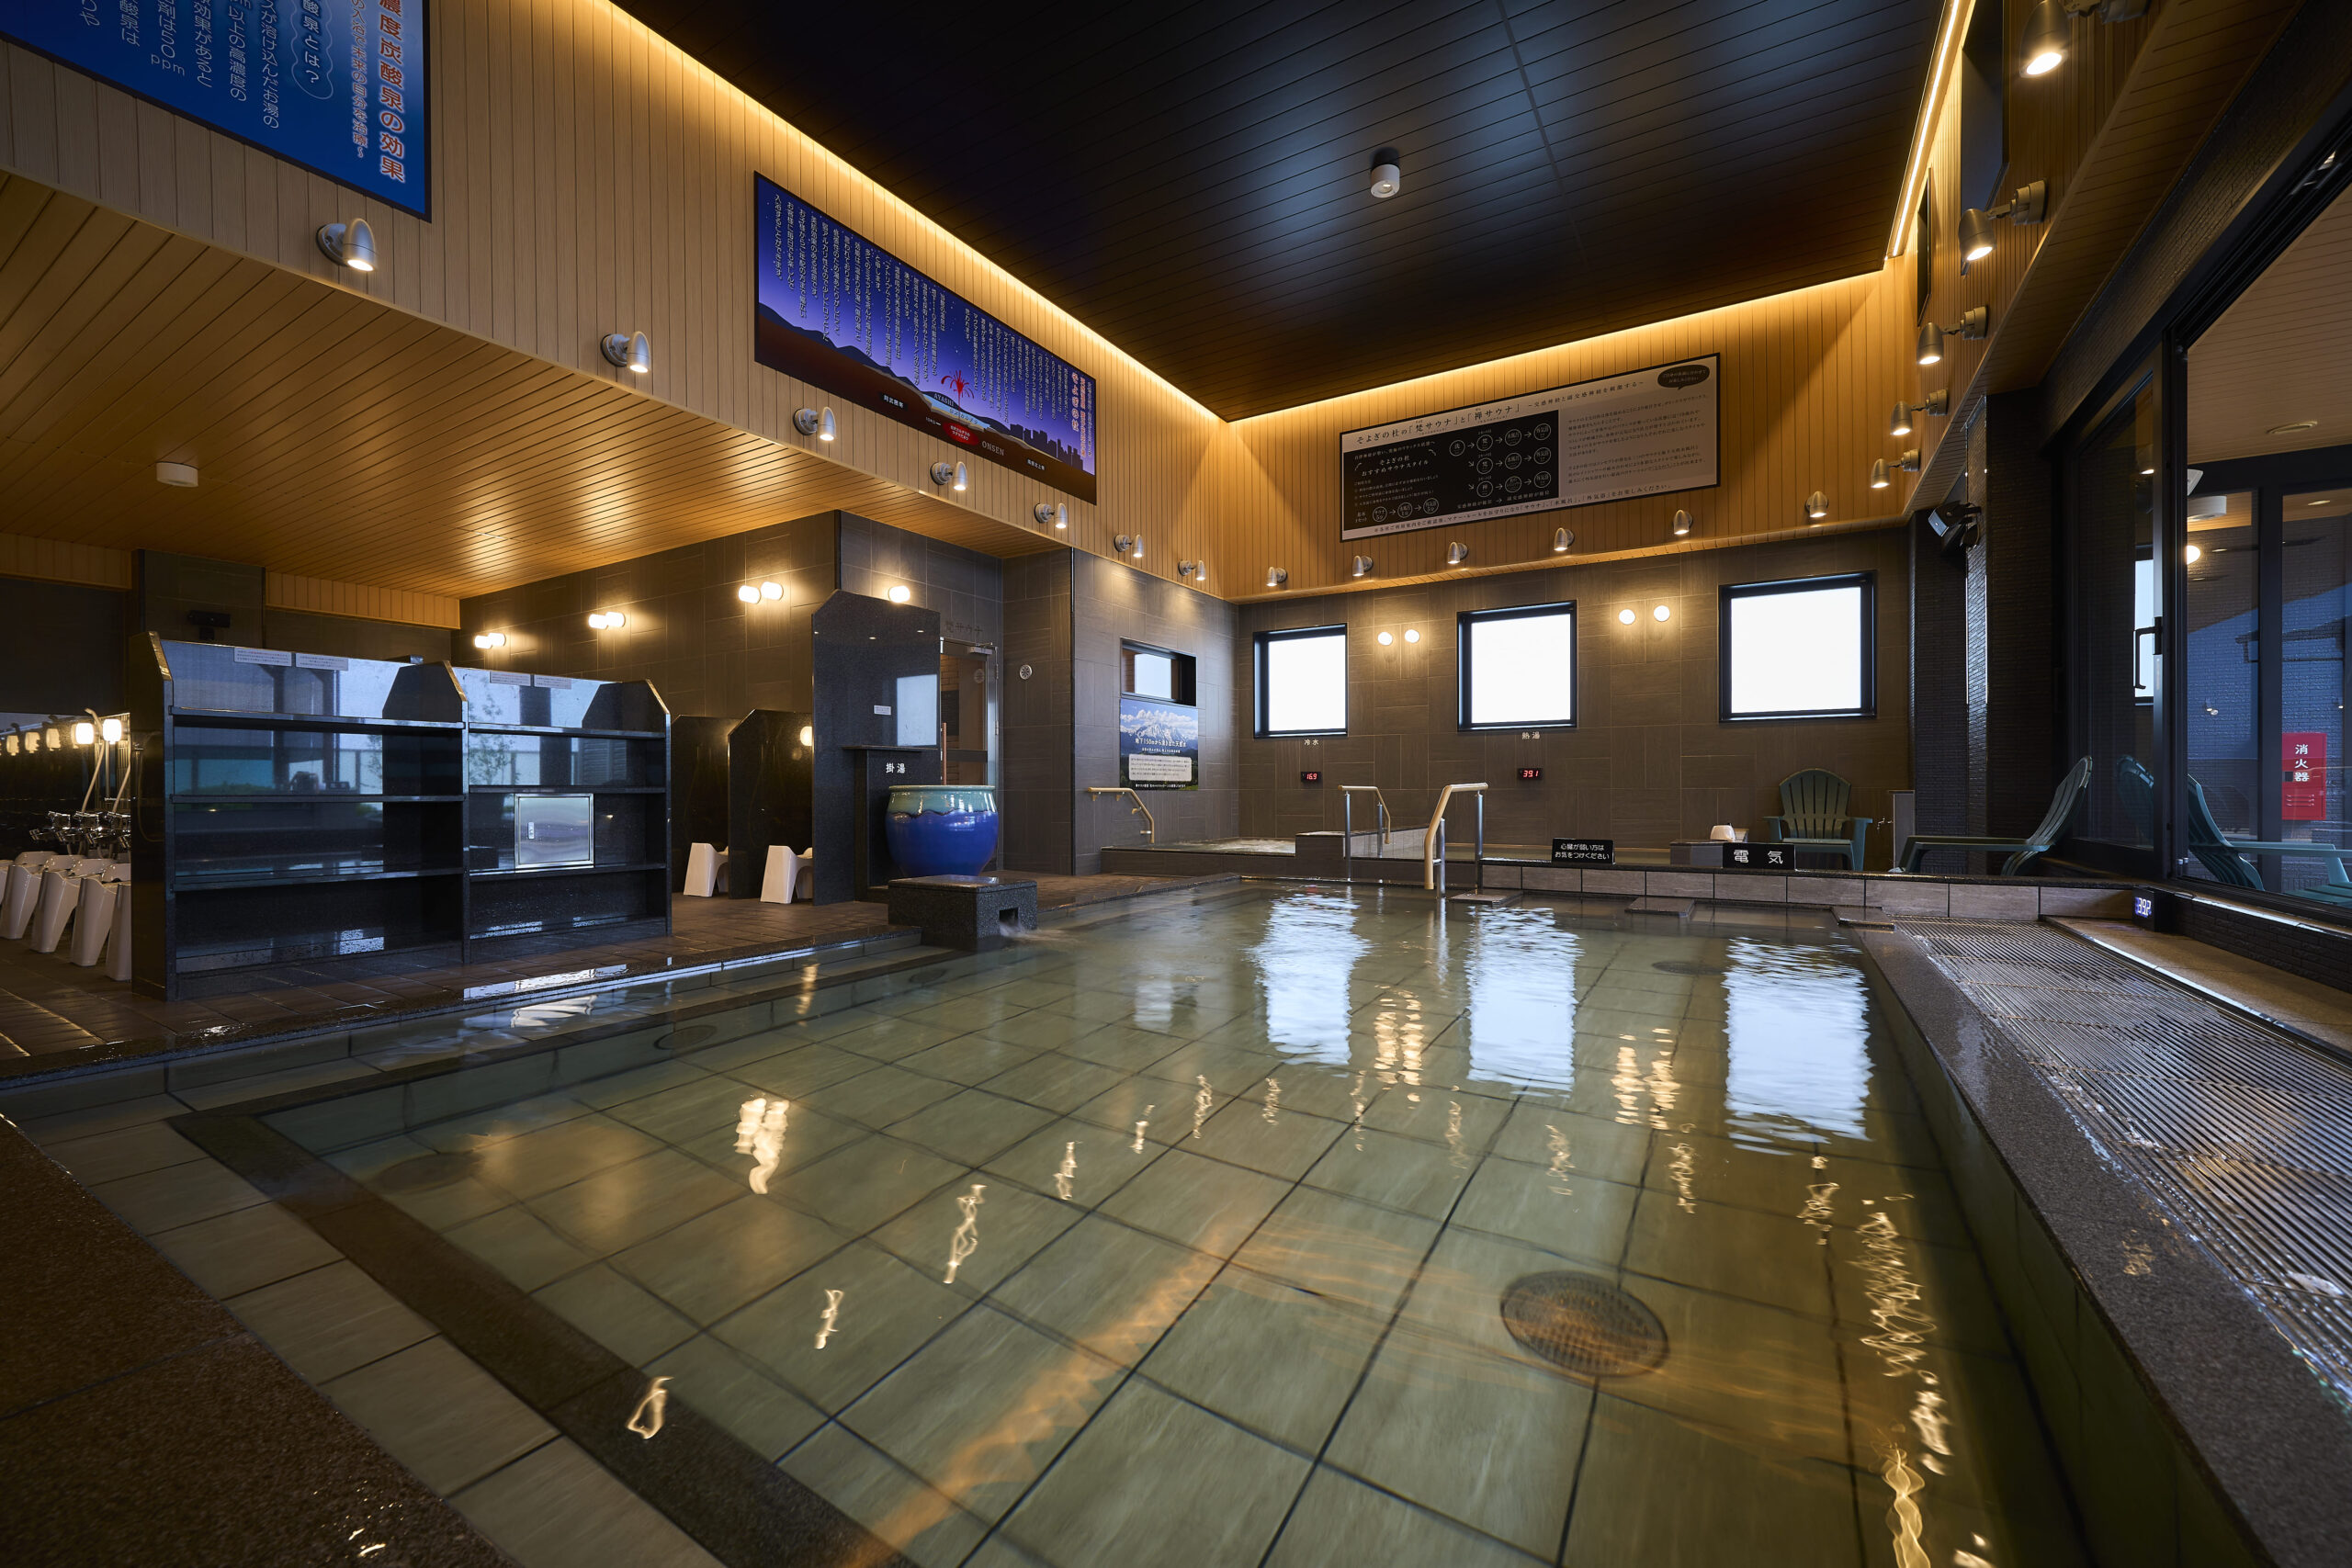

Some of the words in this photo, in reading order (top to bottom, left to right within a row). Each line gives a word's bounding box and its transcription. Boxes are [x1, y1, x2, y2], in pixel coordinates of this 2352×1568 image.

[194, 0, 212, 87] 効果があると
[774, 193, 782, 280] 入浴することができます。
[933, 392, 955, 407] AYASHI
[981, 441, 1005, 457] ONSEN
[1362, 459, 1429, 477] おすすめサウナスタイル
[886, 761, 905, 773] 掛湯
[2294, 743, 2310, 782] 消火器
[1555, 851, 1610, 860] お気をつけください
[1733, 849, 1784, 864] 電気
